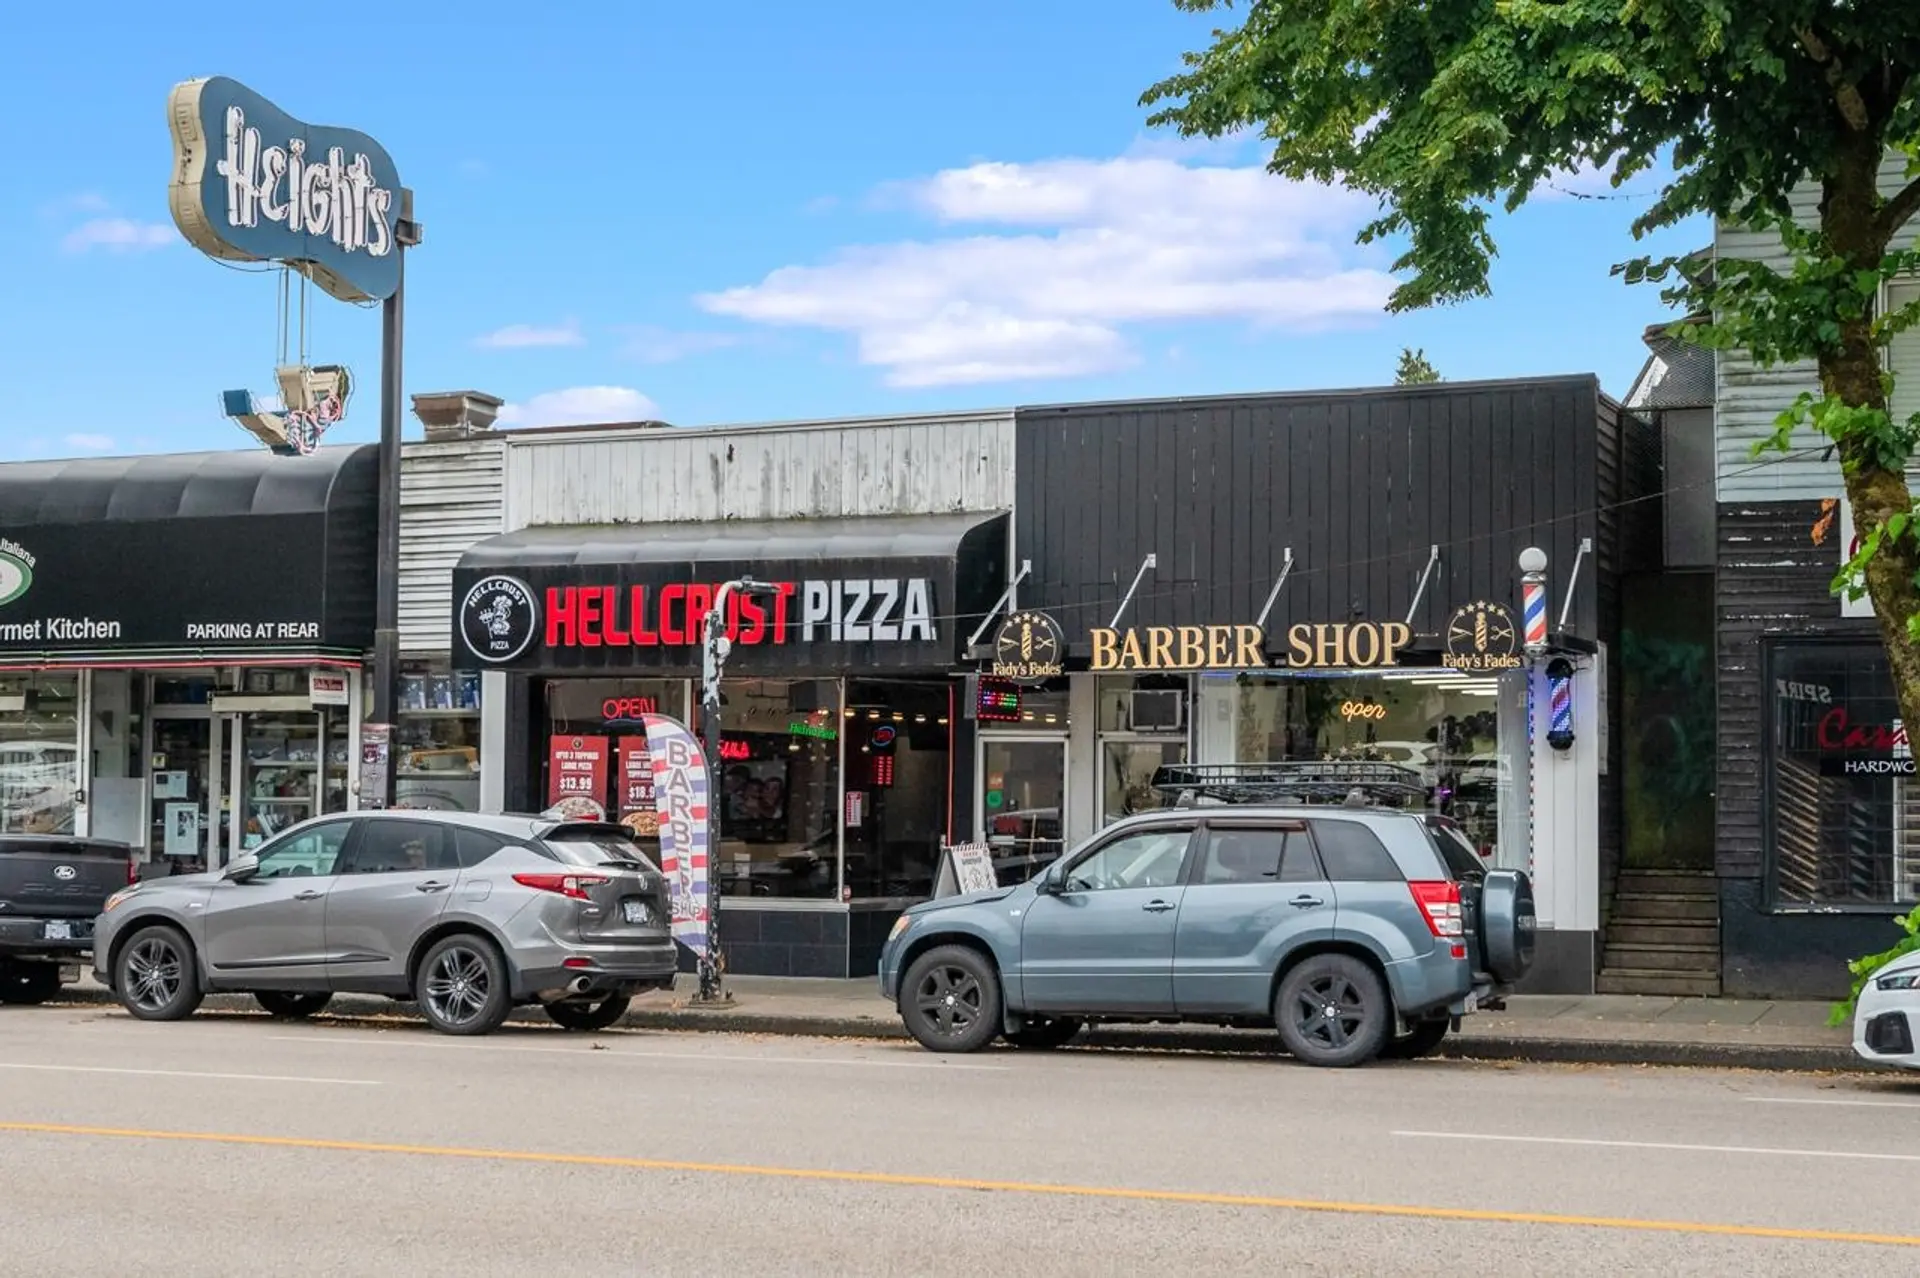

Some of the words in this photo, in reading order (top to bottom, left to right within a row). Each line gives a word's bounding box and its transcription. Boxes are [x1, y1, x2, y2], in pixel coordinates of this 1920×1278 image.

[468, 580, 527, 608] HELLCRUST
[546, 582, 796, 647] HELLCRUST
[803, 578, 932, 642] PIZZA
[47, 617, 121, 640] Kitchen
[187, 623, 252, 639] PARKING
[255, 623, 275, 638] AT
[277, 622, 319, 638] REAR
[490, 640, 511, 650] PIZZA
[1090, 626, 1265, 671] BARBER
[1288, 622, 1410, 667] SHOP
[992, 661, 1028, 679] Fady's
[1029, 661, 1062, 677] Fades
[1442, 652, 1482, 671] Fady's
[1484, 652, 1521, 668] Fades
[602, 696, 656, 720] OPEN
[1341, 701, 1386, 722] open
[560, 776, 593, 790] $13.99
